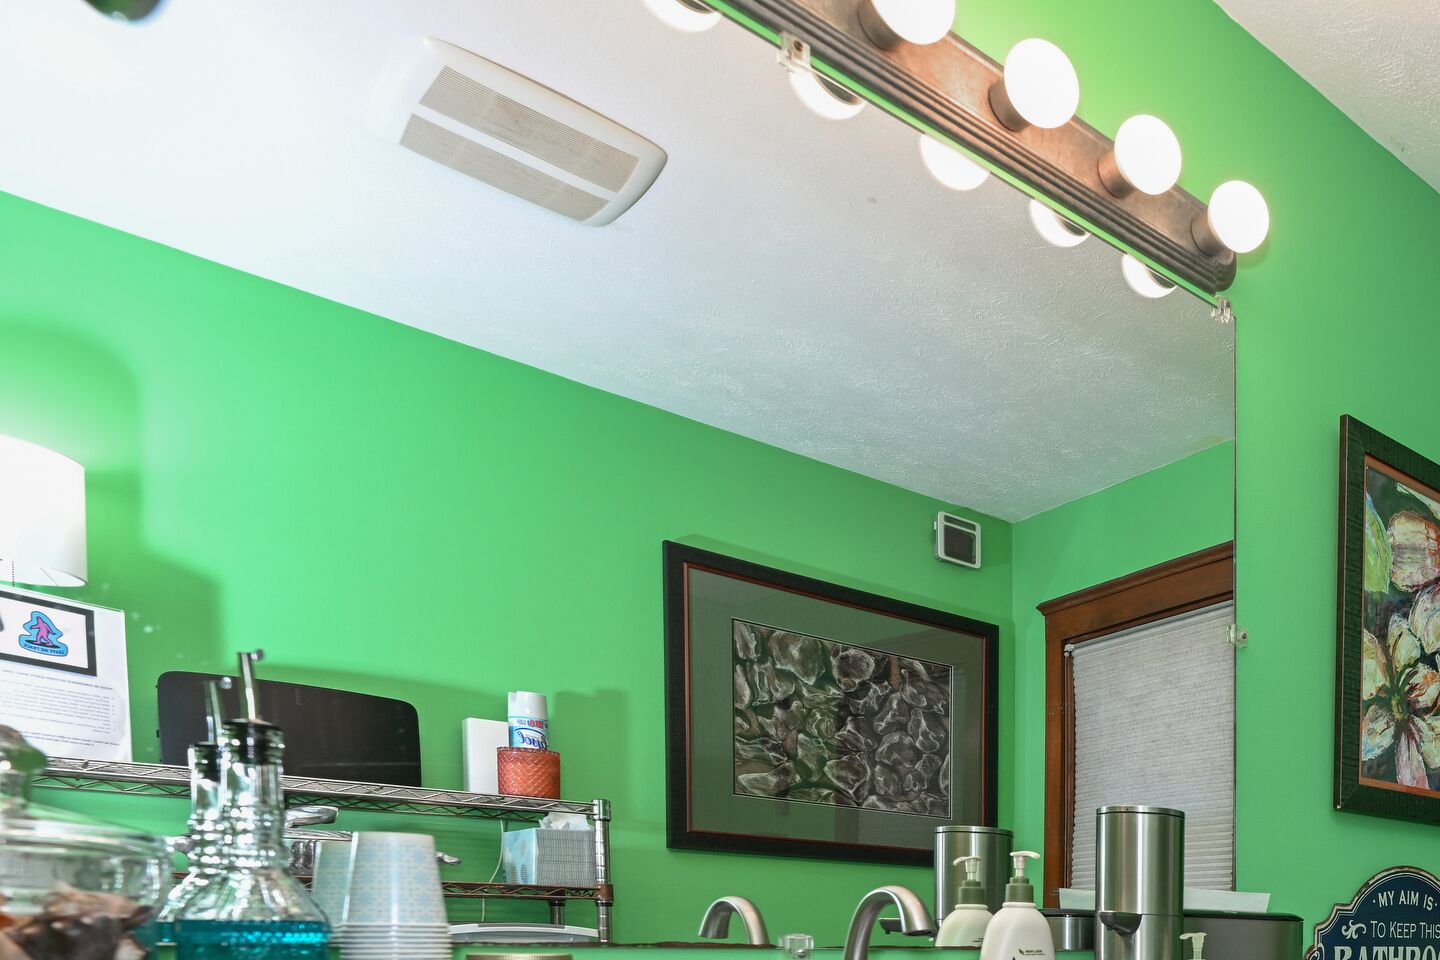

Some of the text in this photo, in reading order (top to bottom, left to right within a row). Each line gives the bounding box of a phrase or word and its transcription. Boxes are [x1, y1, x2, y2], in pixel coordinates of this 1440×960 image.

[1378, 890, 1434, 911] MY AIM IS
[1370, 920, 1386, 938] TO
[1389, 921, 1417, 939] KEEP
